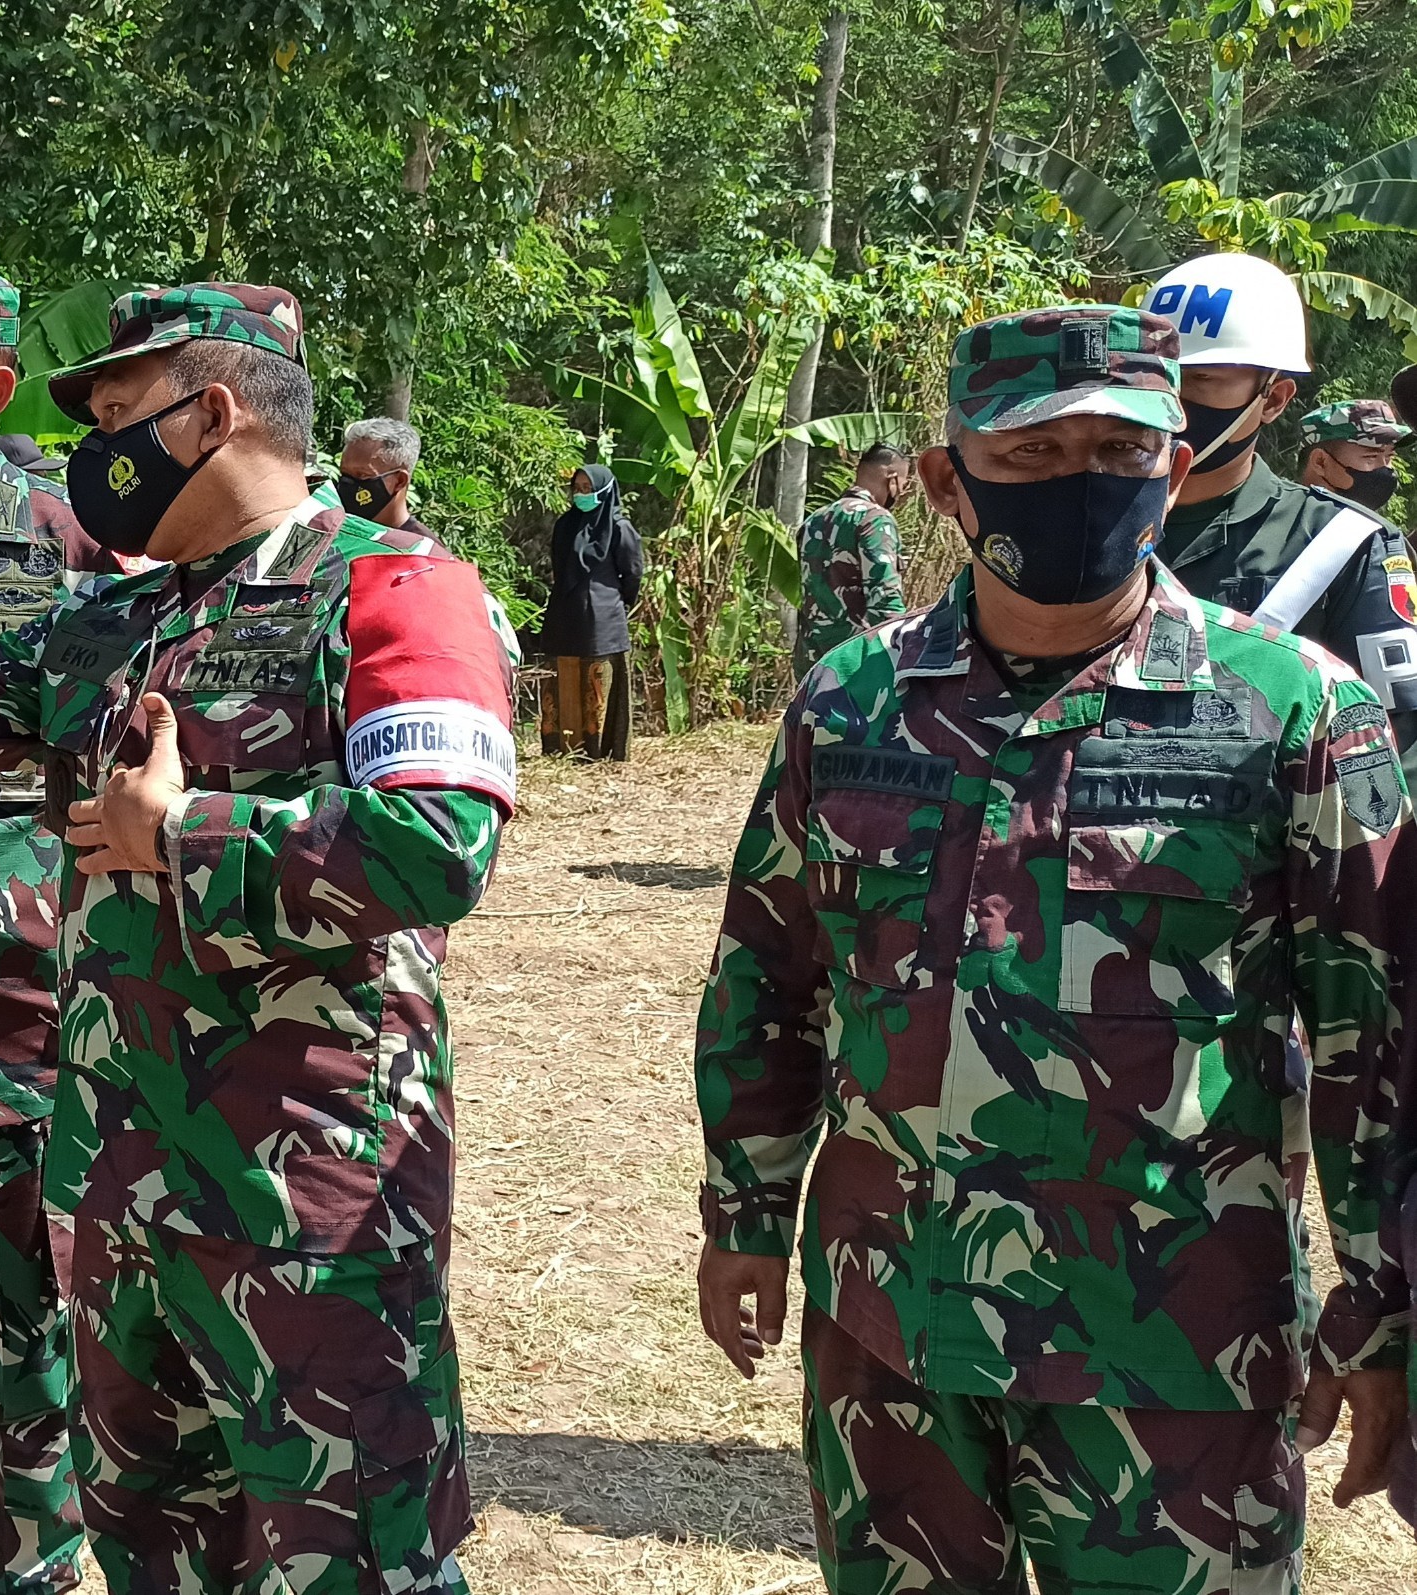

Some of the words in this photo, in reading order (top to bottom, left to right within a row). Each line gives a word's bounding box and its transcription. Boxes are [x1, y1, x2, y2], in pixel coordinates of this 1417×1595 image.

[118, 475, 142, 501] POLRI
[61, 643, 100, 670] EKO
[197, 659, 245, 684] TNI
[352, 721, 464, 772] DANSATGAS
[818, 752, 948, 792] GUNAWAN
[1082, 775, 1161, 806] TNI
[1184, 776, 1252, 814] AD
